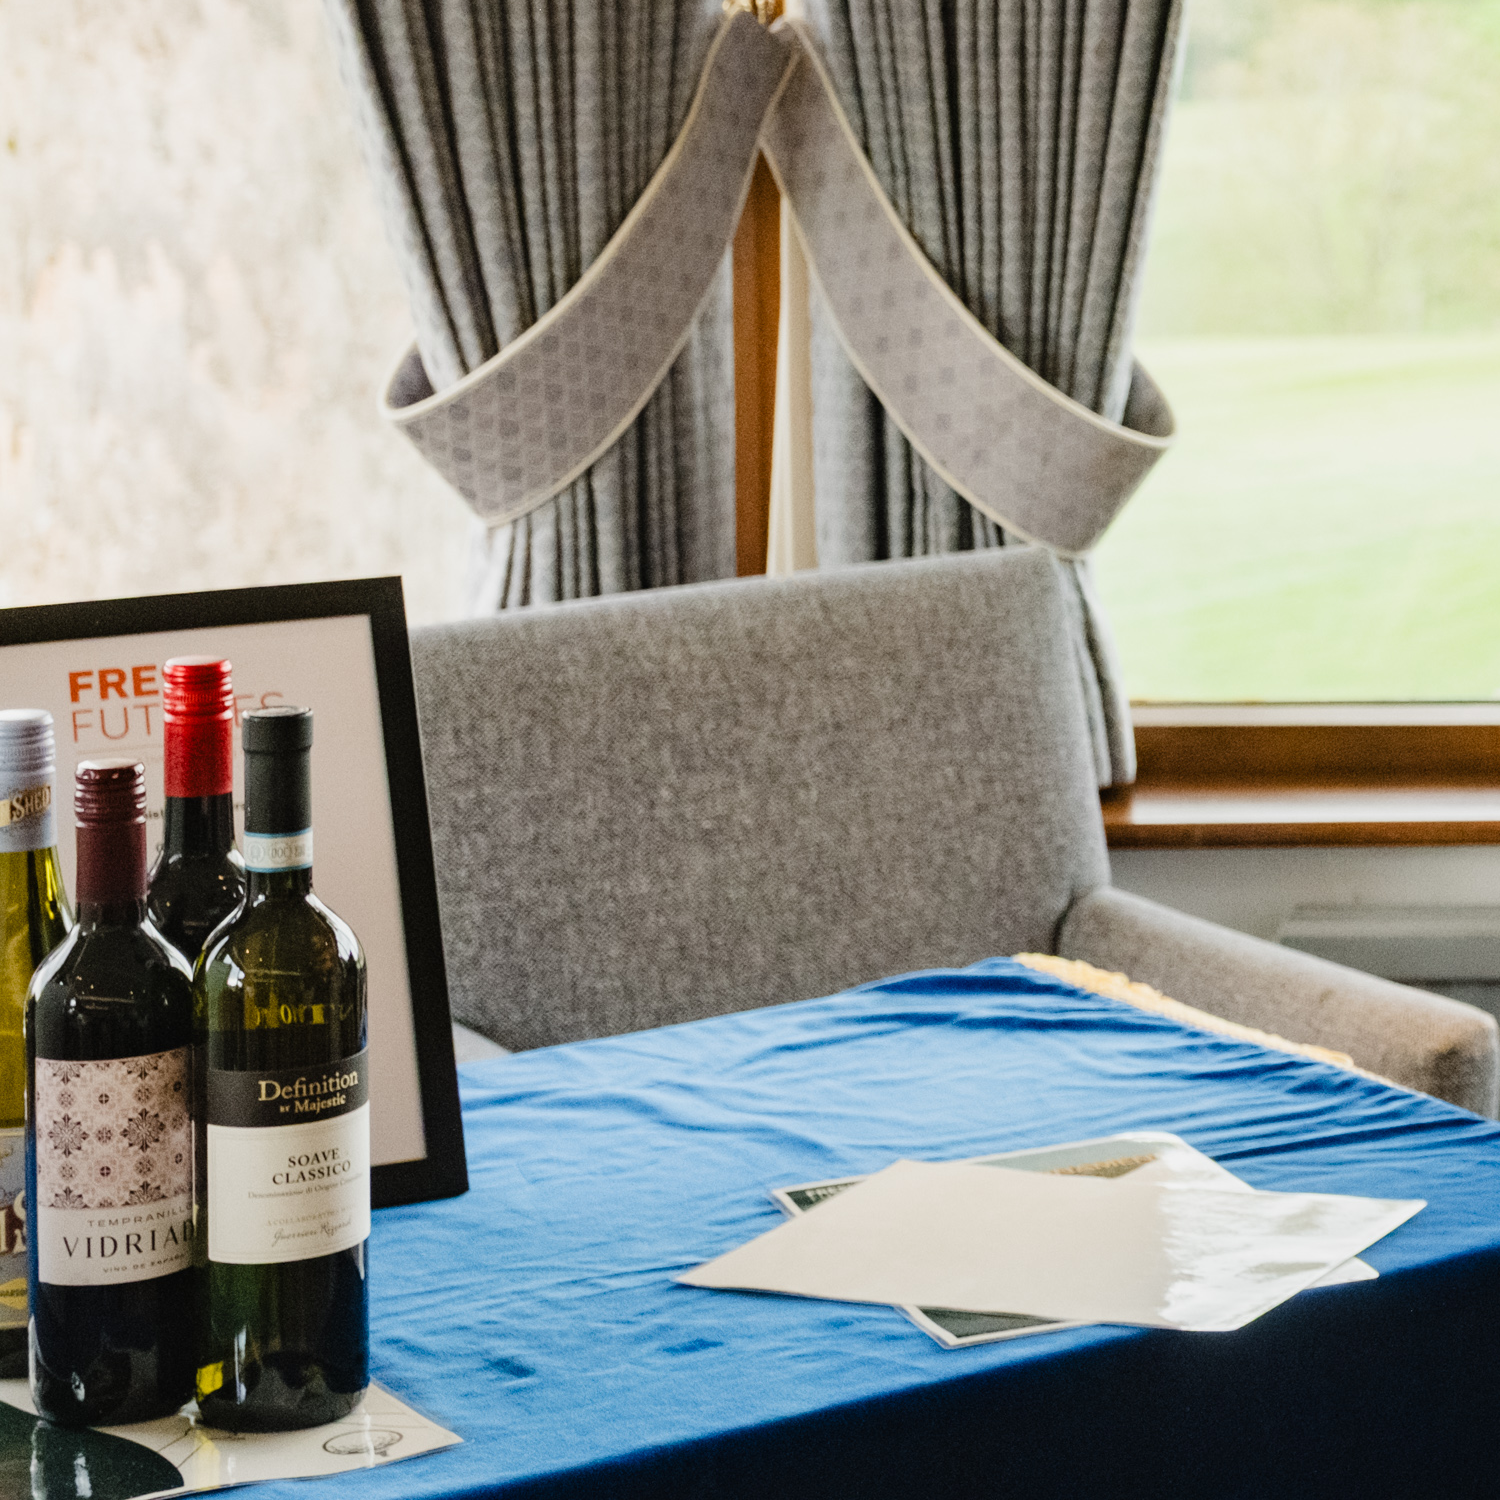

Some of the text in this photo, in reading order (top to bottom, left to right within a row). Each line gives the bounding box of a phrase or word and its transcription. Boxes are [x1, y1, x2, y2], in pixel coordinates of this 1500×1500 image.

[69, 665, 165, 703] FRE
[258, 1071, 359, 1102] Definition
[294, 1092, 346, 1114] Majestic
[287, 1147, 340, 1169] SOAVE
[272, 1160, 351, 1185] CLASSICO
